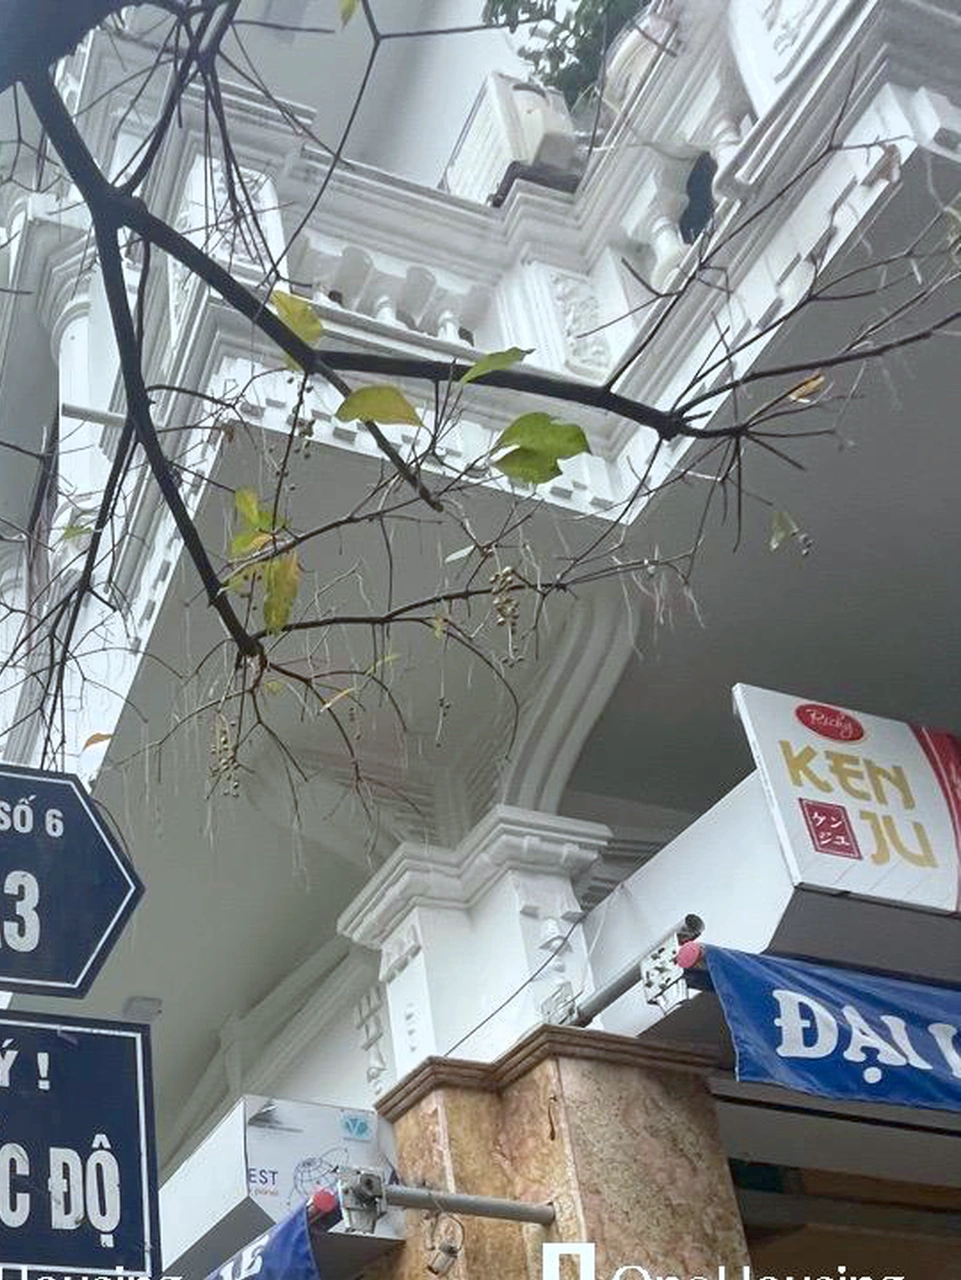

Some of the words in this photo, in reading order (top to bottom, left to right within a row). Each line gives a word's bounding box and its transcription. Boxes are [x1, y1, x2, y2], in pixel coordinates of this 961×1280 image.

[778, 740, 916, 810] KEN
[45, 809, 65, 838] 6
[860, 810, 938, 868] JU
[772, 990, 933, 1084] ĐẠI
[37, 1052, 51, 1091] !
[48, 1133, 122, 1248] ĐỘ
